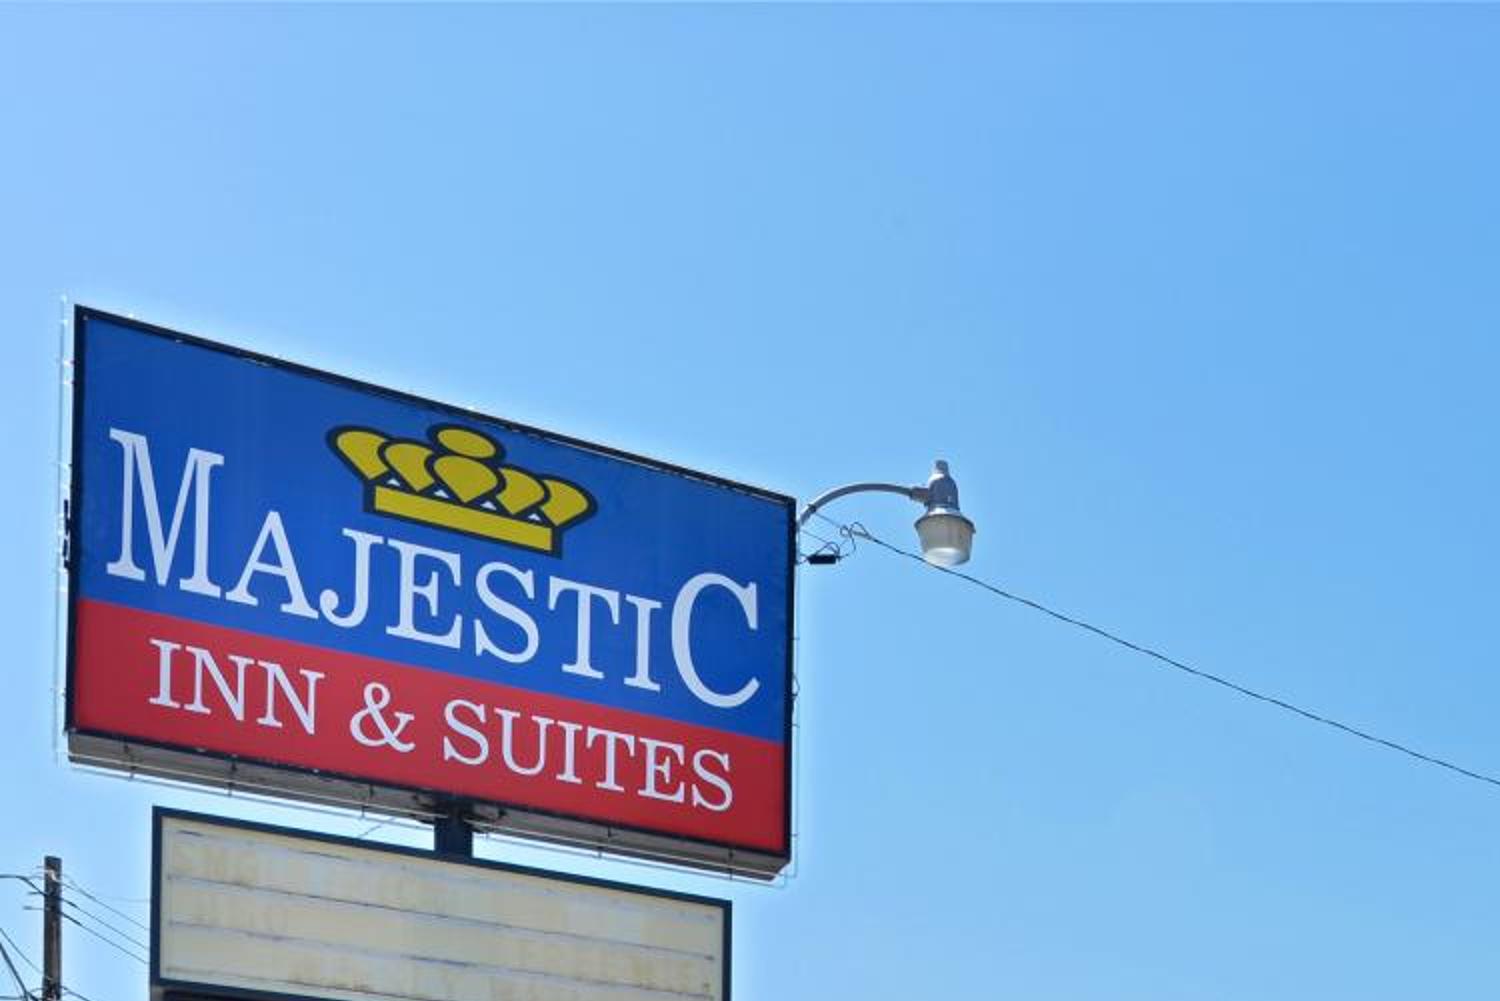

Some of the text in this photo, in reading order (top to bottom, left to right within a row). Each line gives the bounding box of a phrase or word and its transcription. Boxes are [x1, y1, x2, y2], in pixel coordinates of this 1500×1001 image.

[106, 428, 761, 709] MAJESTIC
[149, 638, 734, 813] INN & SUITES
